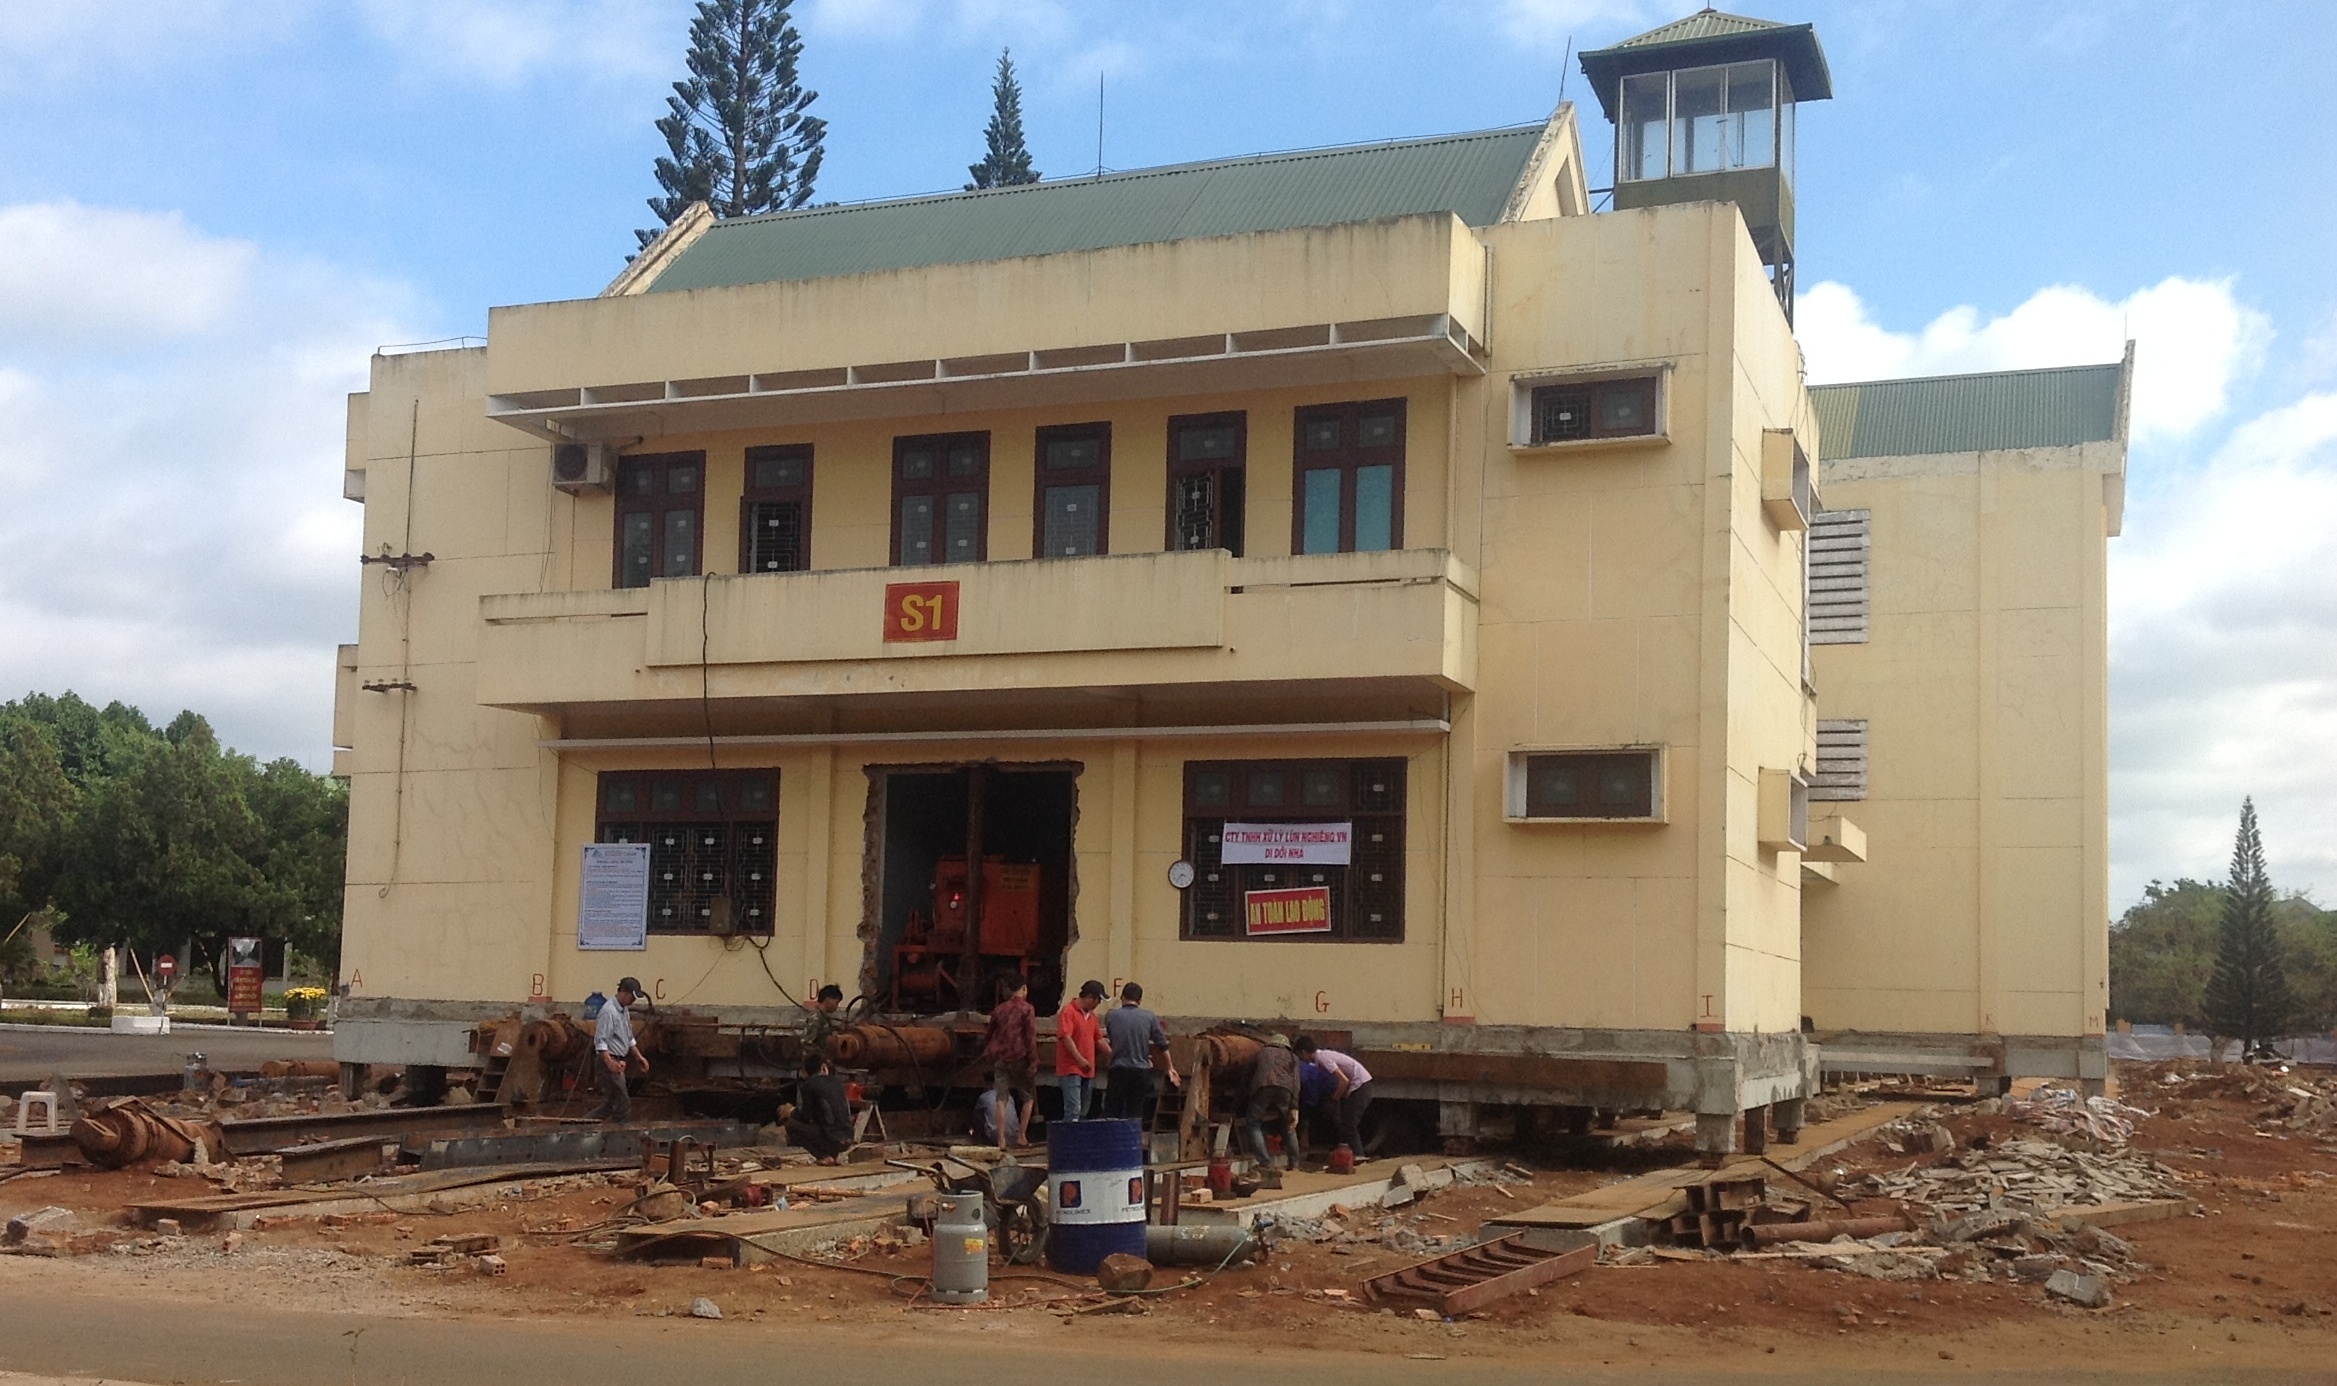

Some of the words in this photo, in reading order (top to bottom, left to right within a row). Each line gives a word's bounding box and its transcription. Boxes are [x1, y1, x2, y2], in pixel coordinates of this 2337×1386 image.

[900, 594, 943, 632] S1
[1225, 831, 1239, 843] CTY
[1241, 831, 1261, 843] TNHH
[351, 968, 363, 988] A
[532, 973, 545, 996] B
[655, 978, 667, 1000] C
[1113, 977, 1123, 998] F
[1315, 990, 1330, 1013] G
[1451, 987, 1463, 1009] H
[1700, 994, 1718, 1018] I
